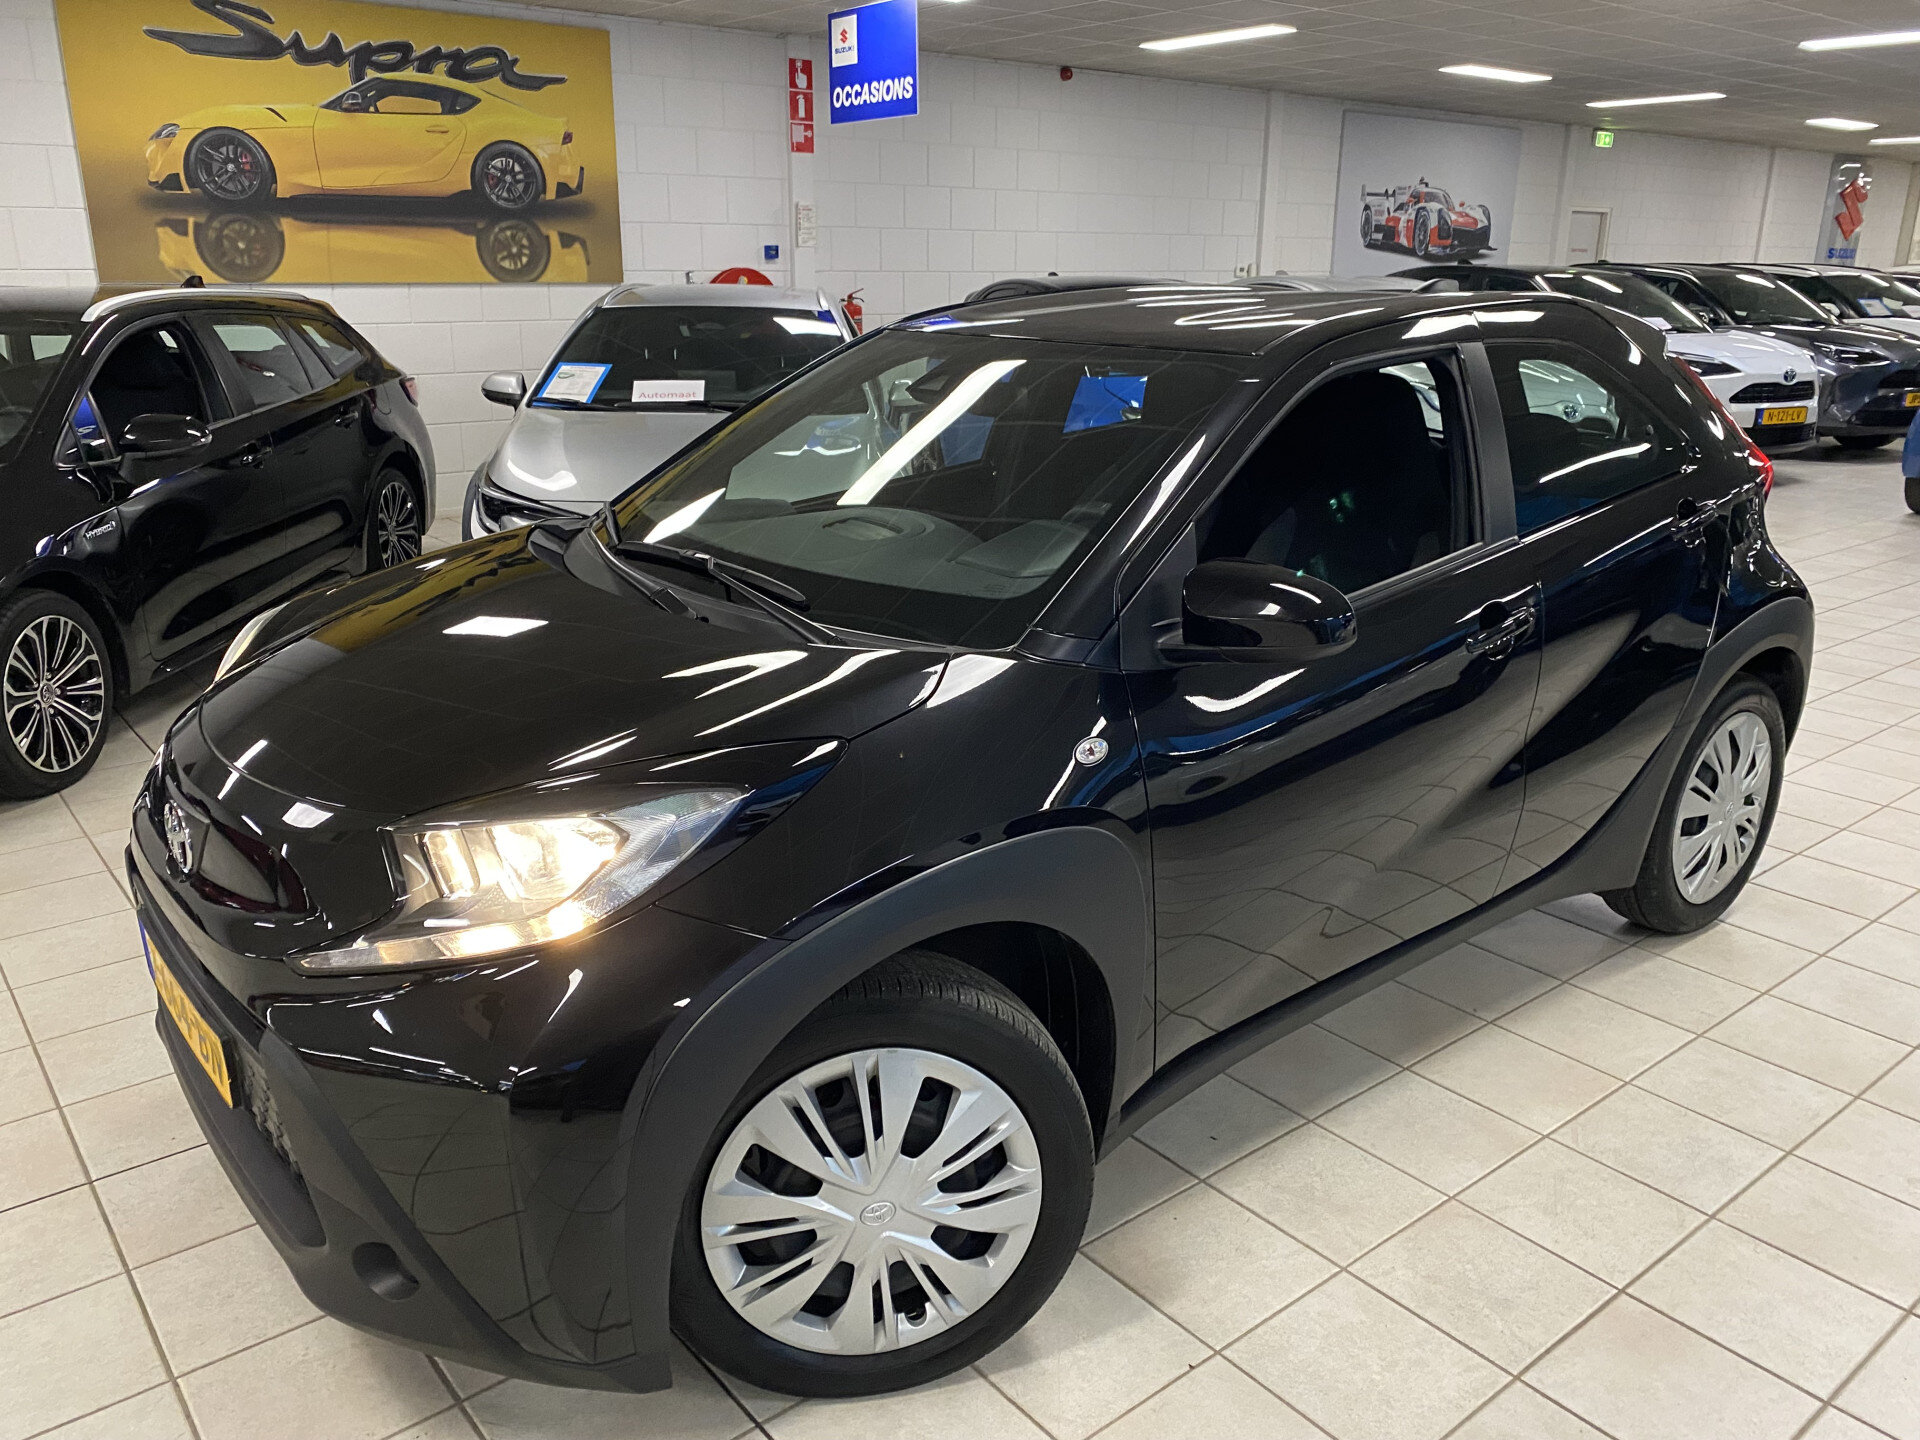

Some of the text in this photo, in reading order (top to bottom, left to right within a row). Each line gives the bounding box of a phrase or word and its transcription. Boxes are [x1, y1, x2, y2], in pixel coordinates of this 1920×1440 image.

[143, 0, 568, 91] Supra
[834, 45, 855, 55] SUZUKI
[833, 76, 914, 108] OCCASIONS
[638, 391, 697, 399] Automaat
[1767, 409, 1803, 422] N-121-LV
